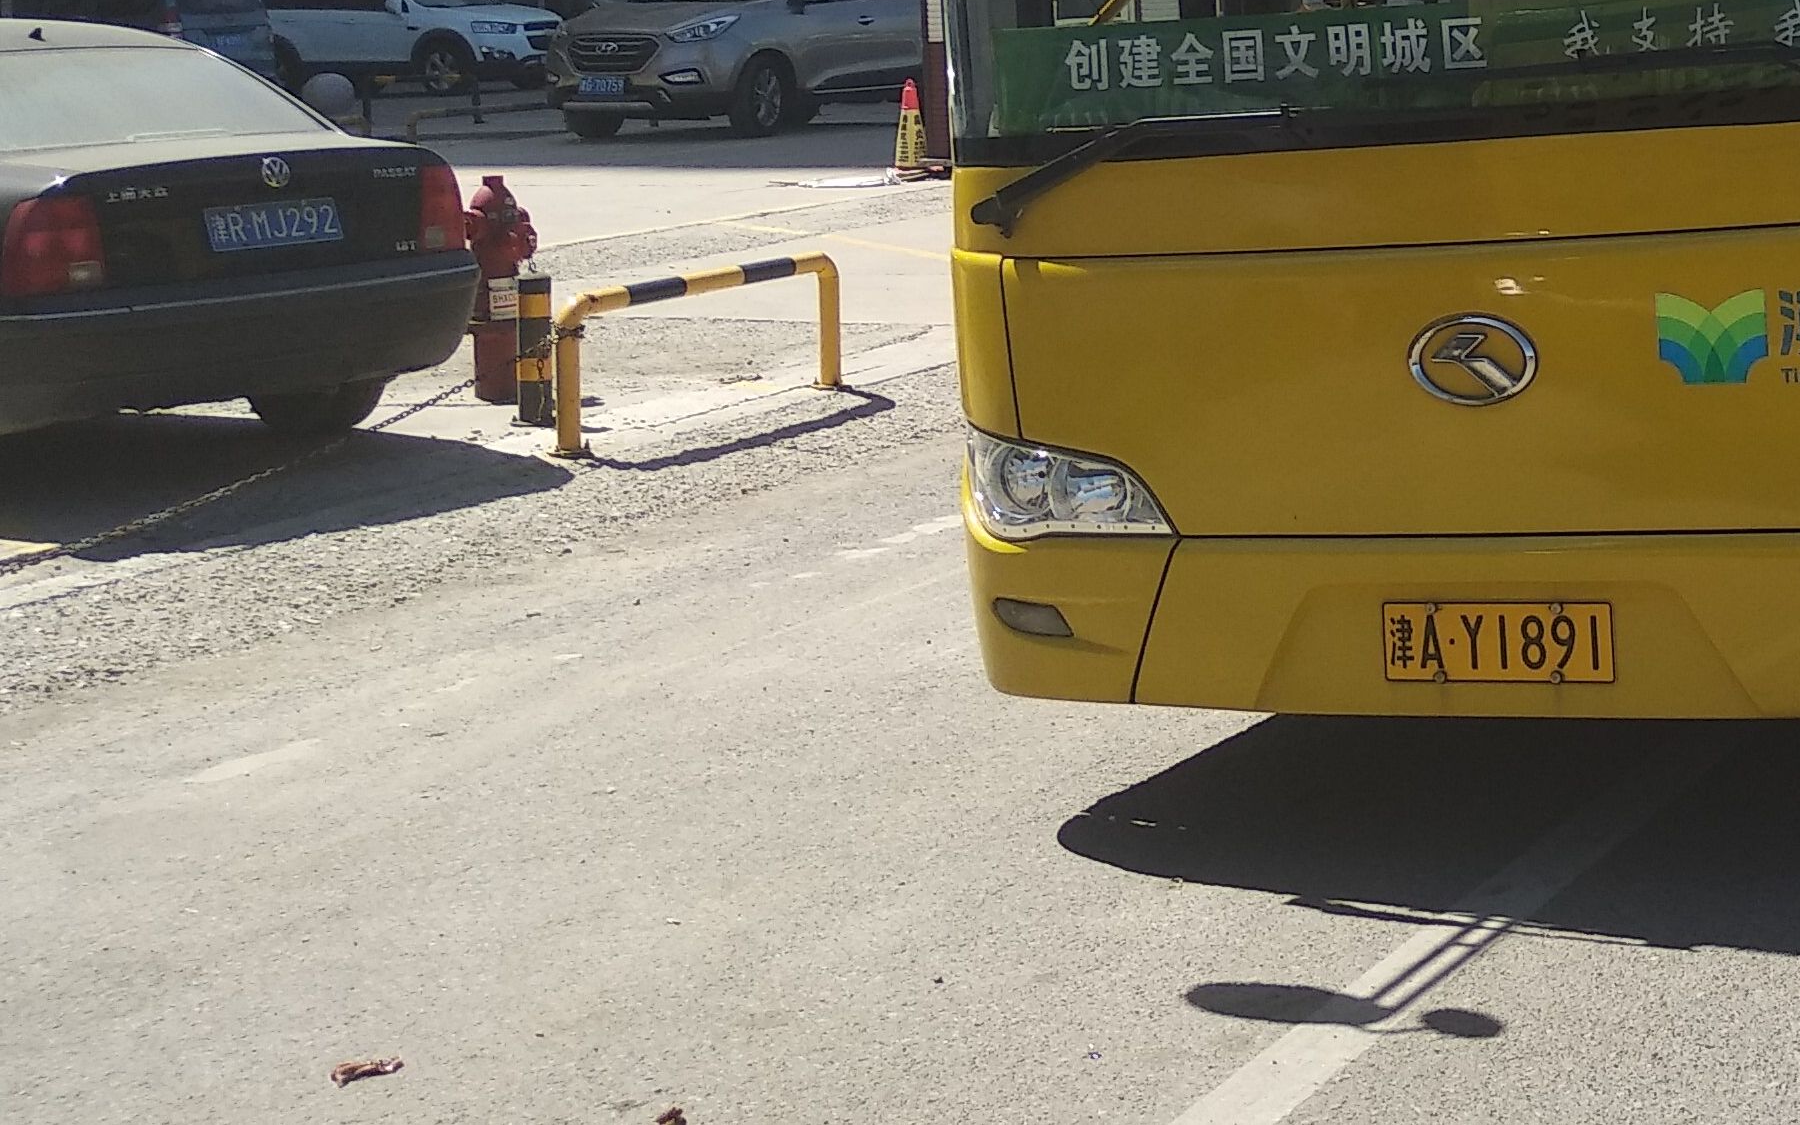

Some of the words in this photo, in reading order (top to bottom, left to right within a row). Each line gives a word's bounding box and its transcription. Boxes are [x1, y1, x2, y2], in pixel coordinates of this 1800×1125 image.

[1064, 16, 1488, 91] 创建全国文明城区
[1562, 2, 1735, 58] 我支持
